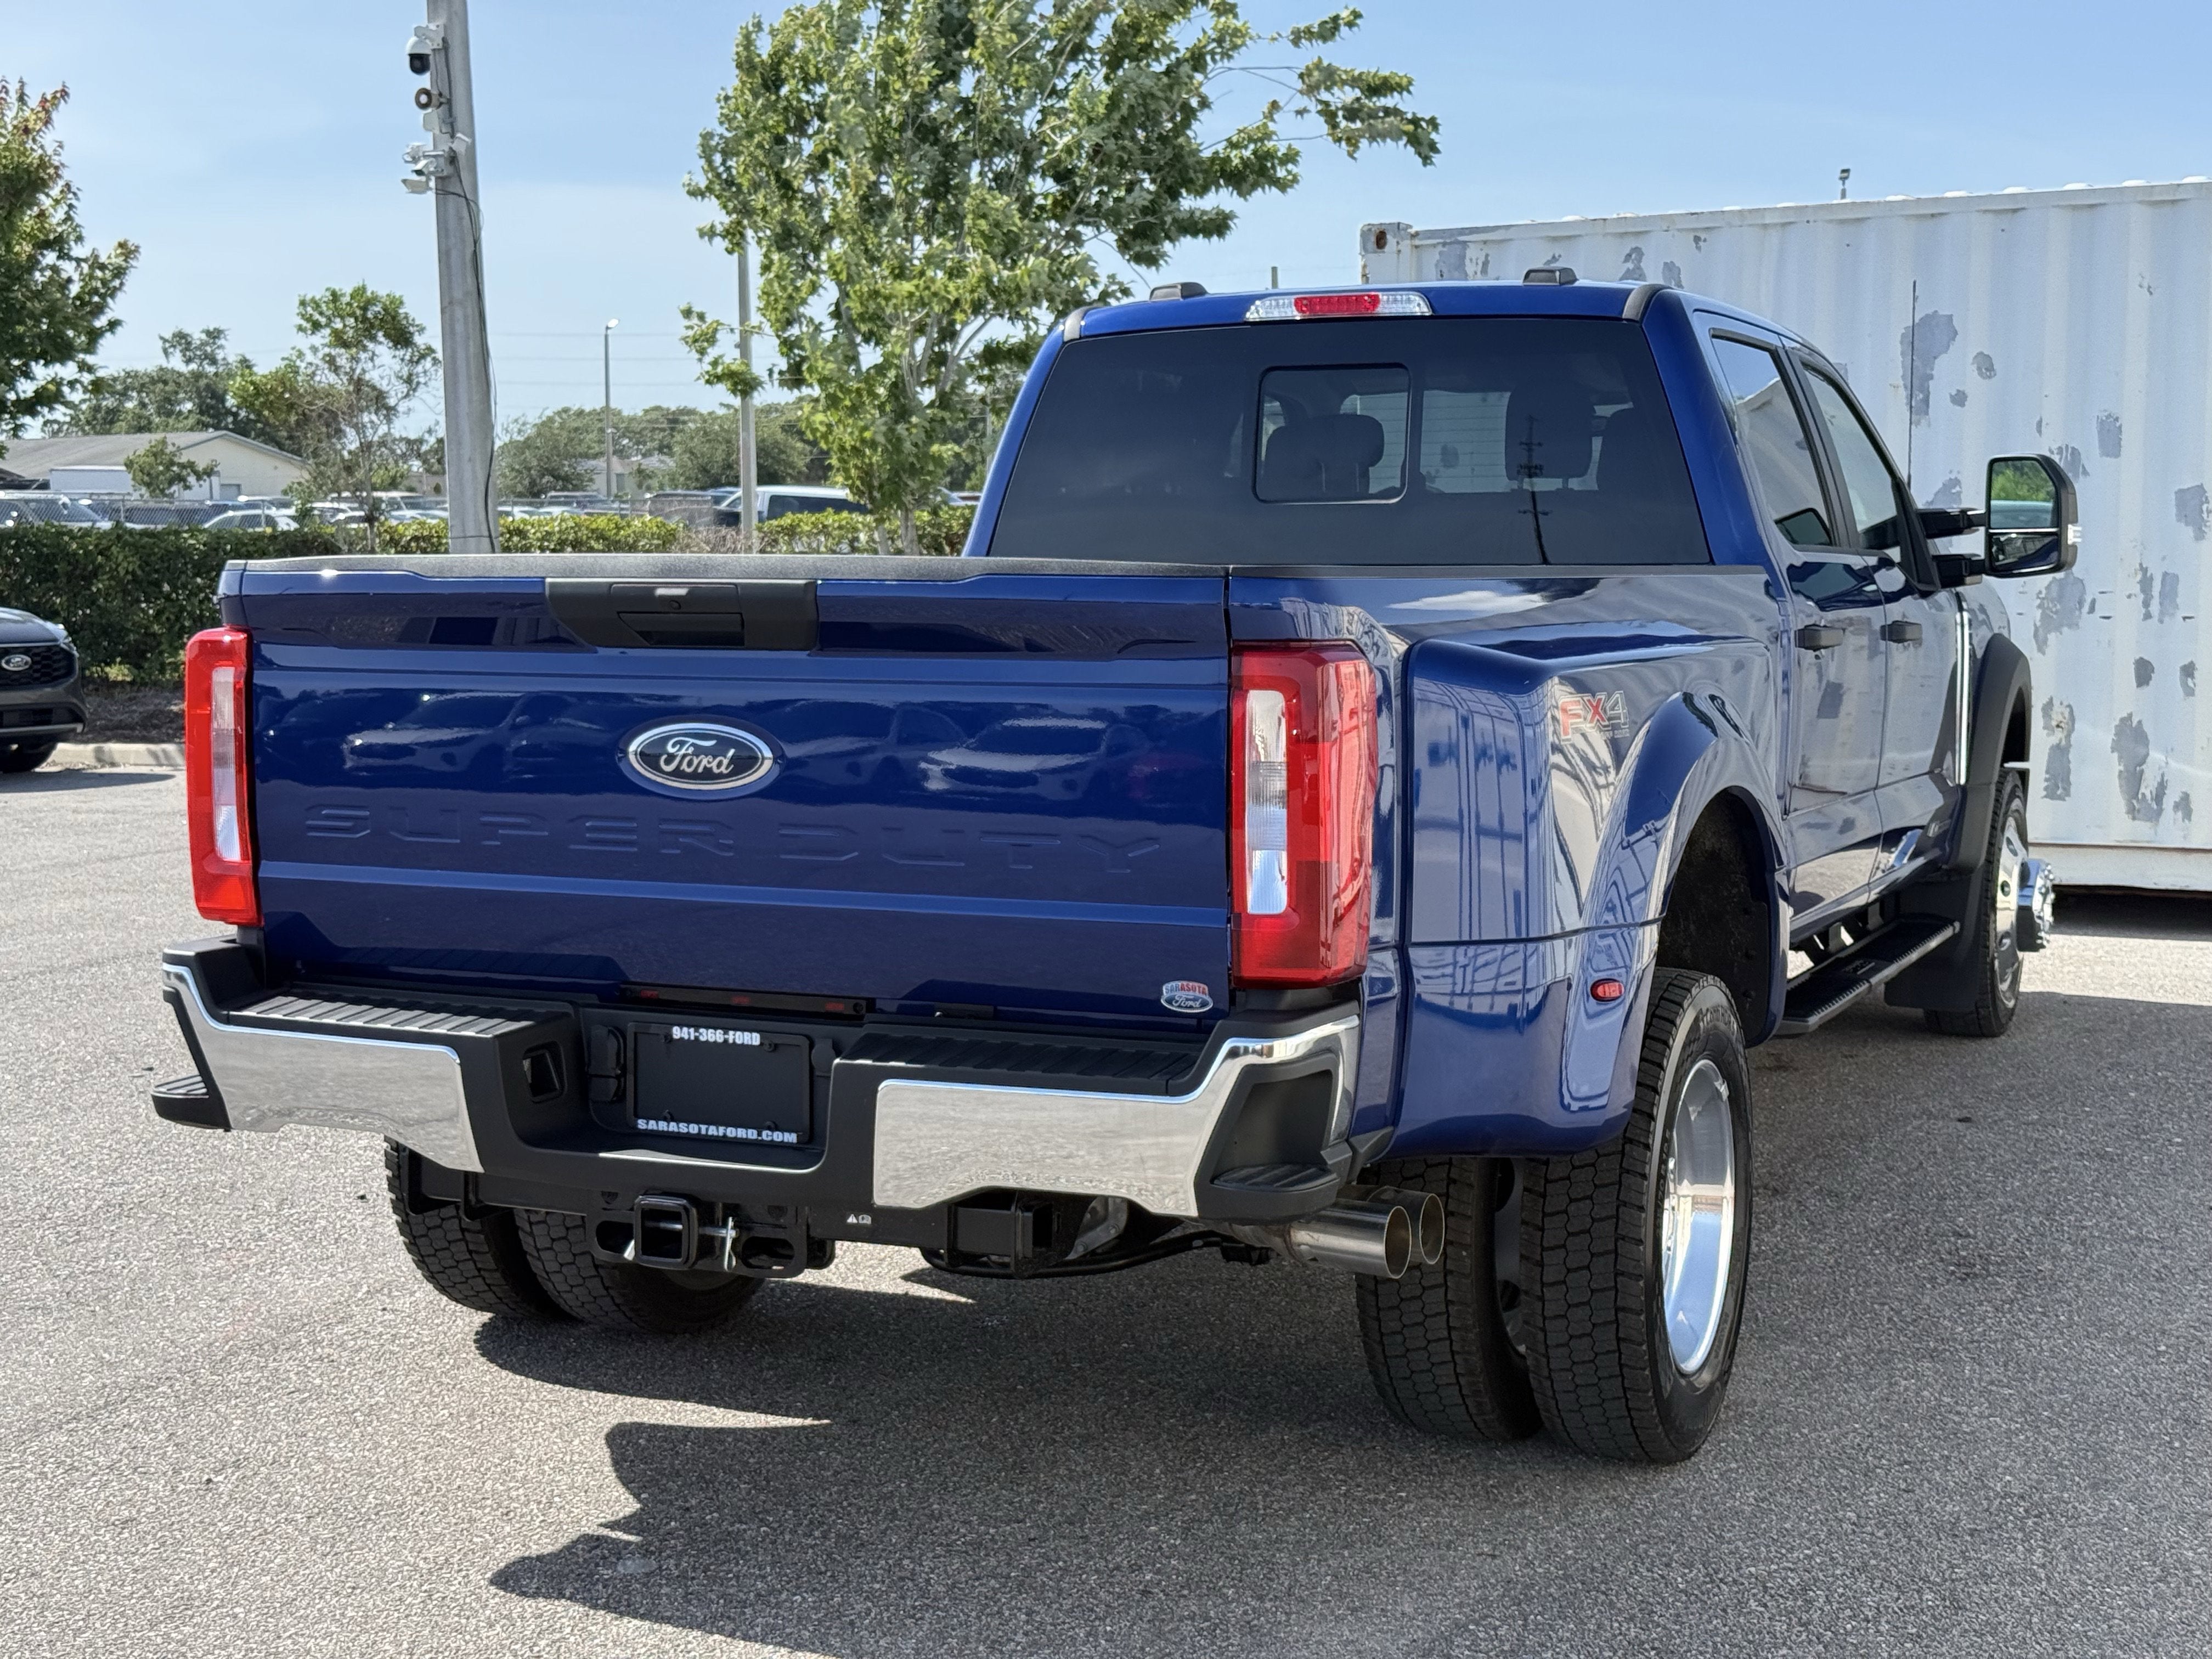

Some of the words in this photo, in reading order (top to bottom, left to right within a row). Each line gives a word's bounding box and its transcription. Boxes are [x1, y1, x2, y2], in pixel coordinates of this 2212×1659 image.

[1559, 690, 1629, 744] FX4
[660, 737, 735, 774] Ford
[305, 805, 735, 856] SUPER
[778, 823, 1161, 873] DUTY
[1165, 983, 1207, 995] SARASOTA
[1172, 994, 1202, 1008] Ford
[672, 1026, 761, 1046] 941-366-FORD
[637, 1119, 798, 1143] SARASOTAFORD.COM
